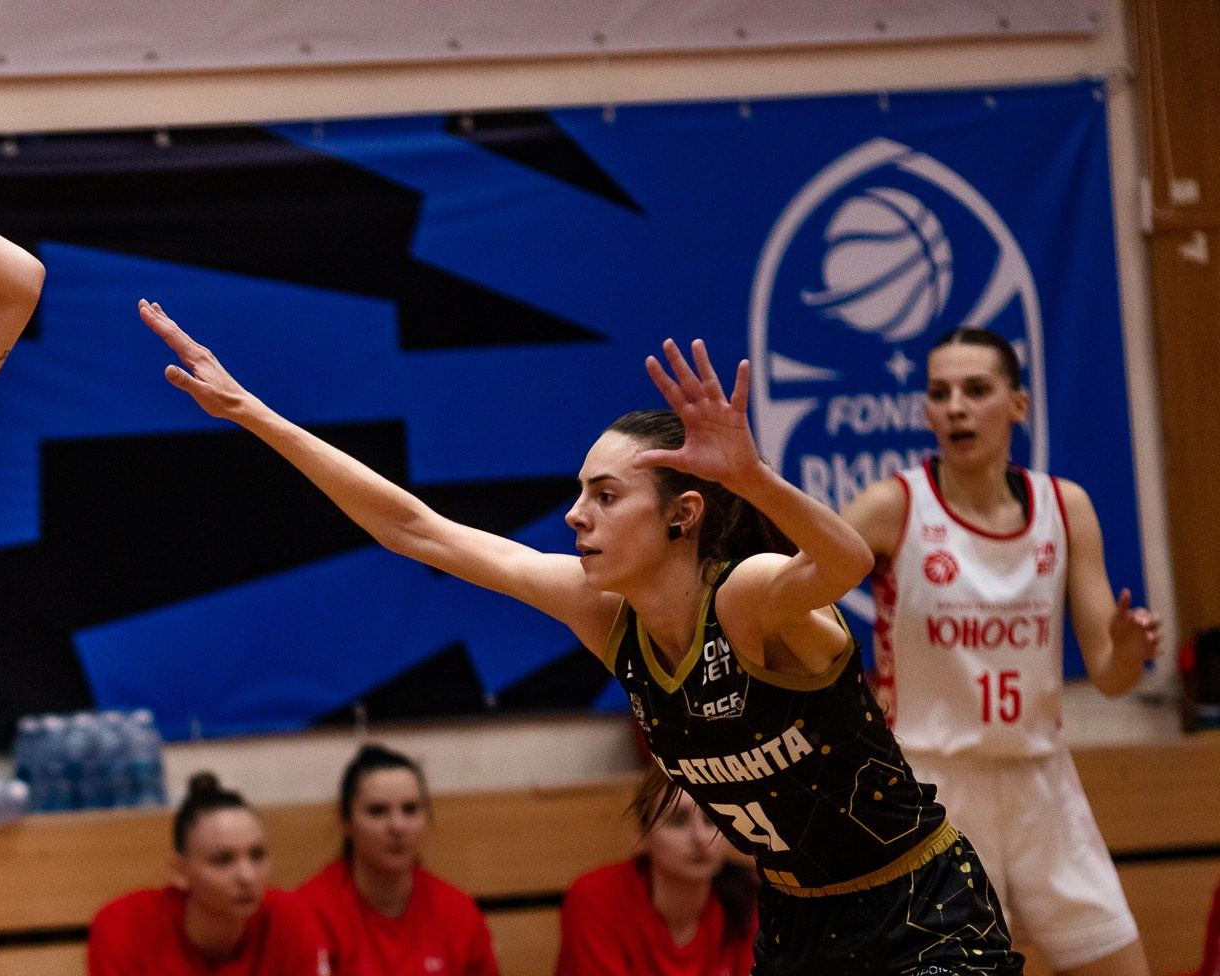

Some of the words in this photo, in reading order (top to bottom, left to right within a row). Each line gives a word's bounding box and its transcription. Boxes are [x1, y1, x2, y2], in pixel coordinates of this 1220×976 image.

[704, 637, 730, 661] ON
[702, 654, 730, 686] ET
[977, 670, 1021, 724] 15
